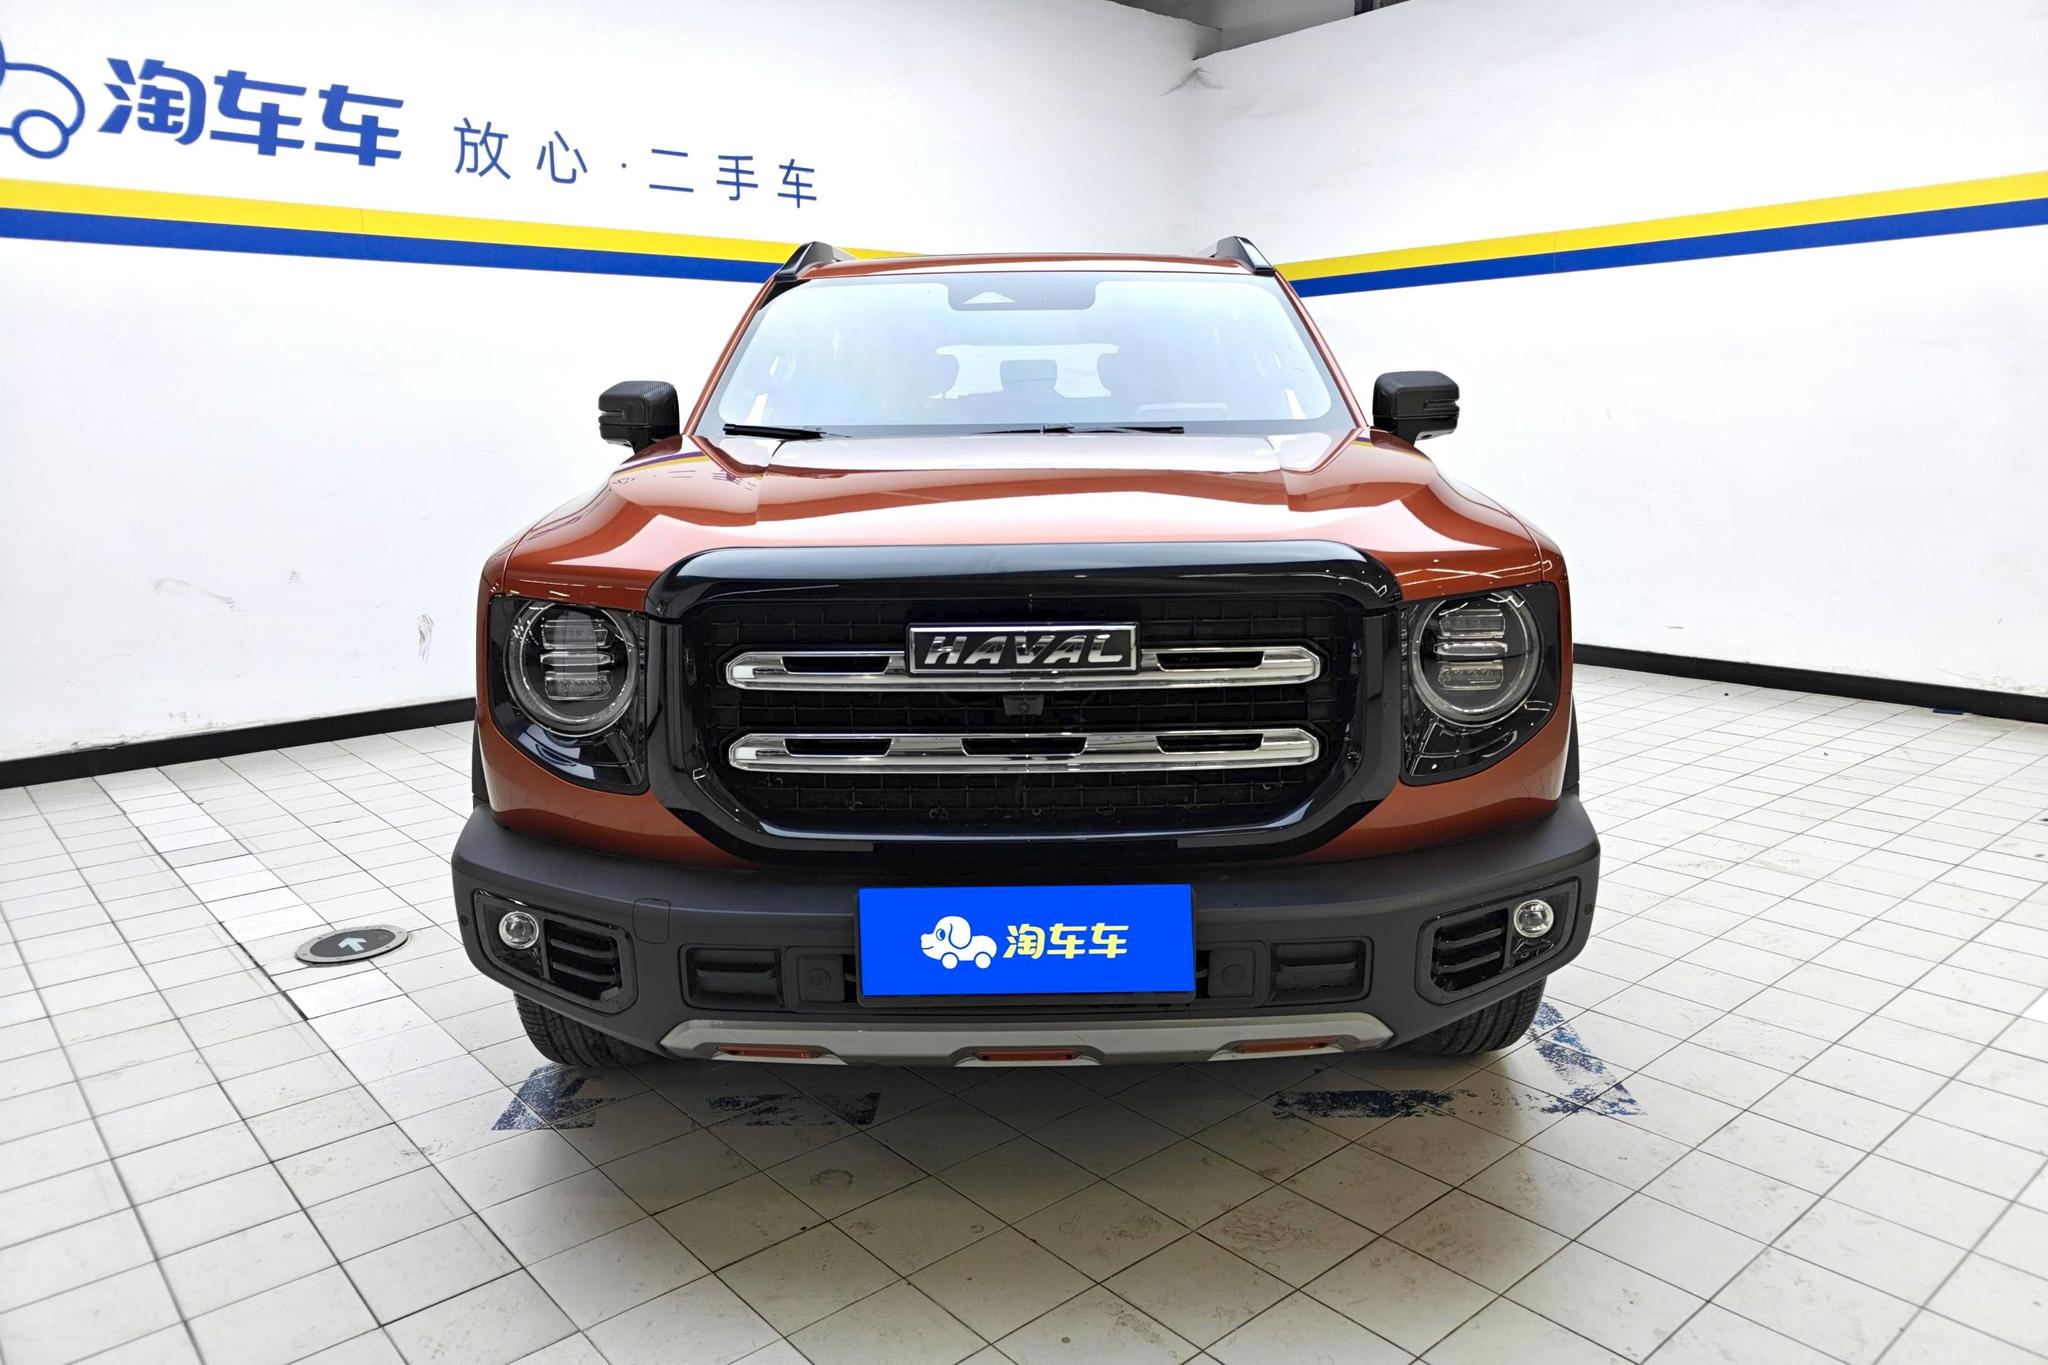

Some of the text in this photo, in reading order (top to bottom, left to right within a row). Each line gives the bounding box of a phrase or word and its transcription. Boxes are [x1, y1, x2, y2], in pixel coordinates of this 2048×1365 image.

[98, 57, 404, 167] 淘车车
[924, 634, 1123, 665] HAVAL
